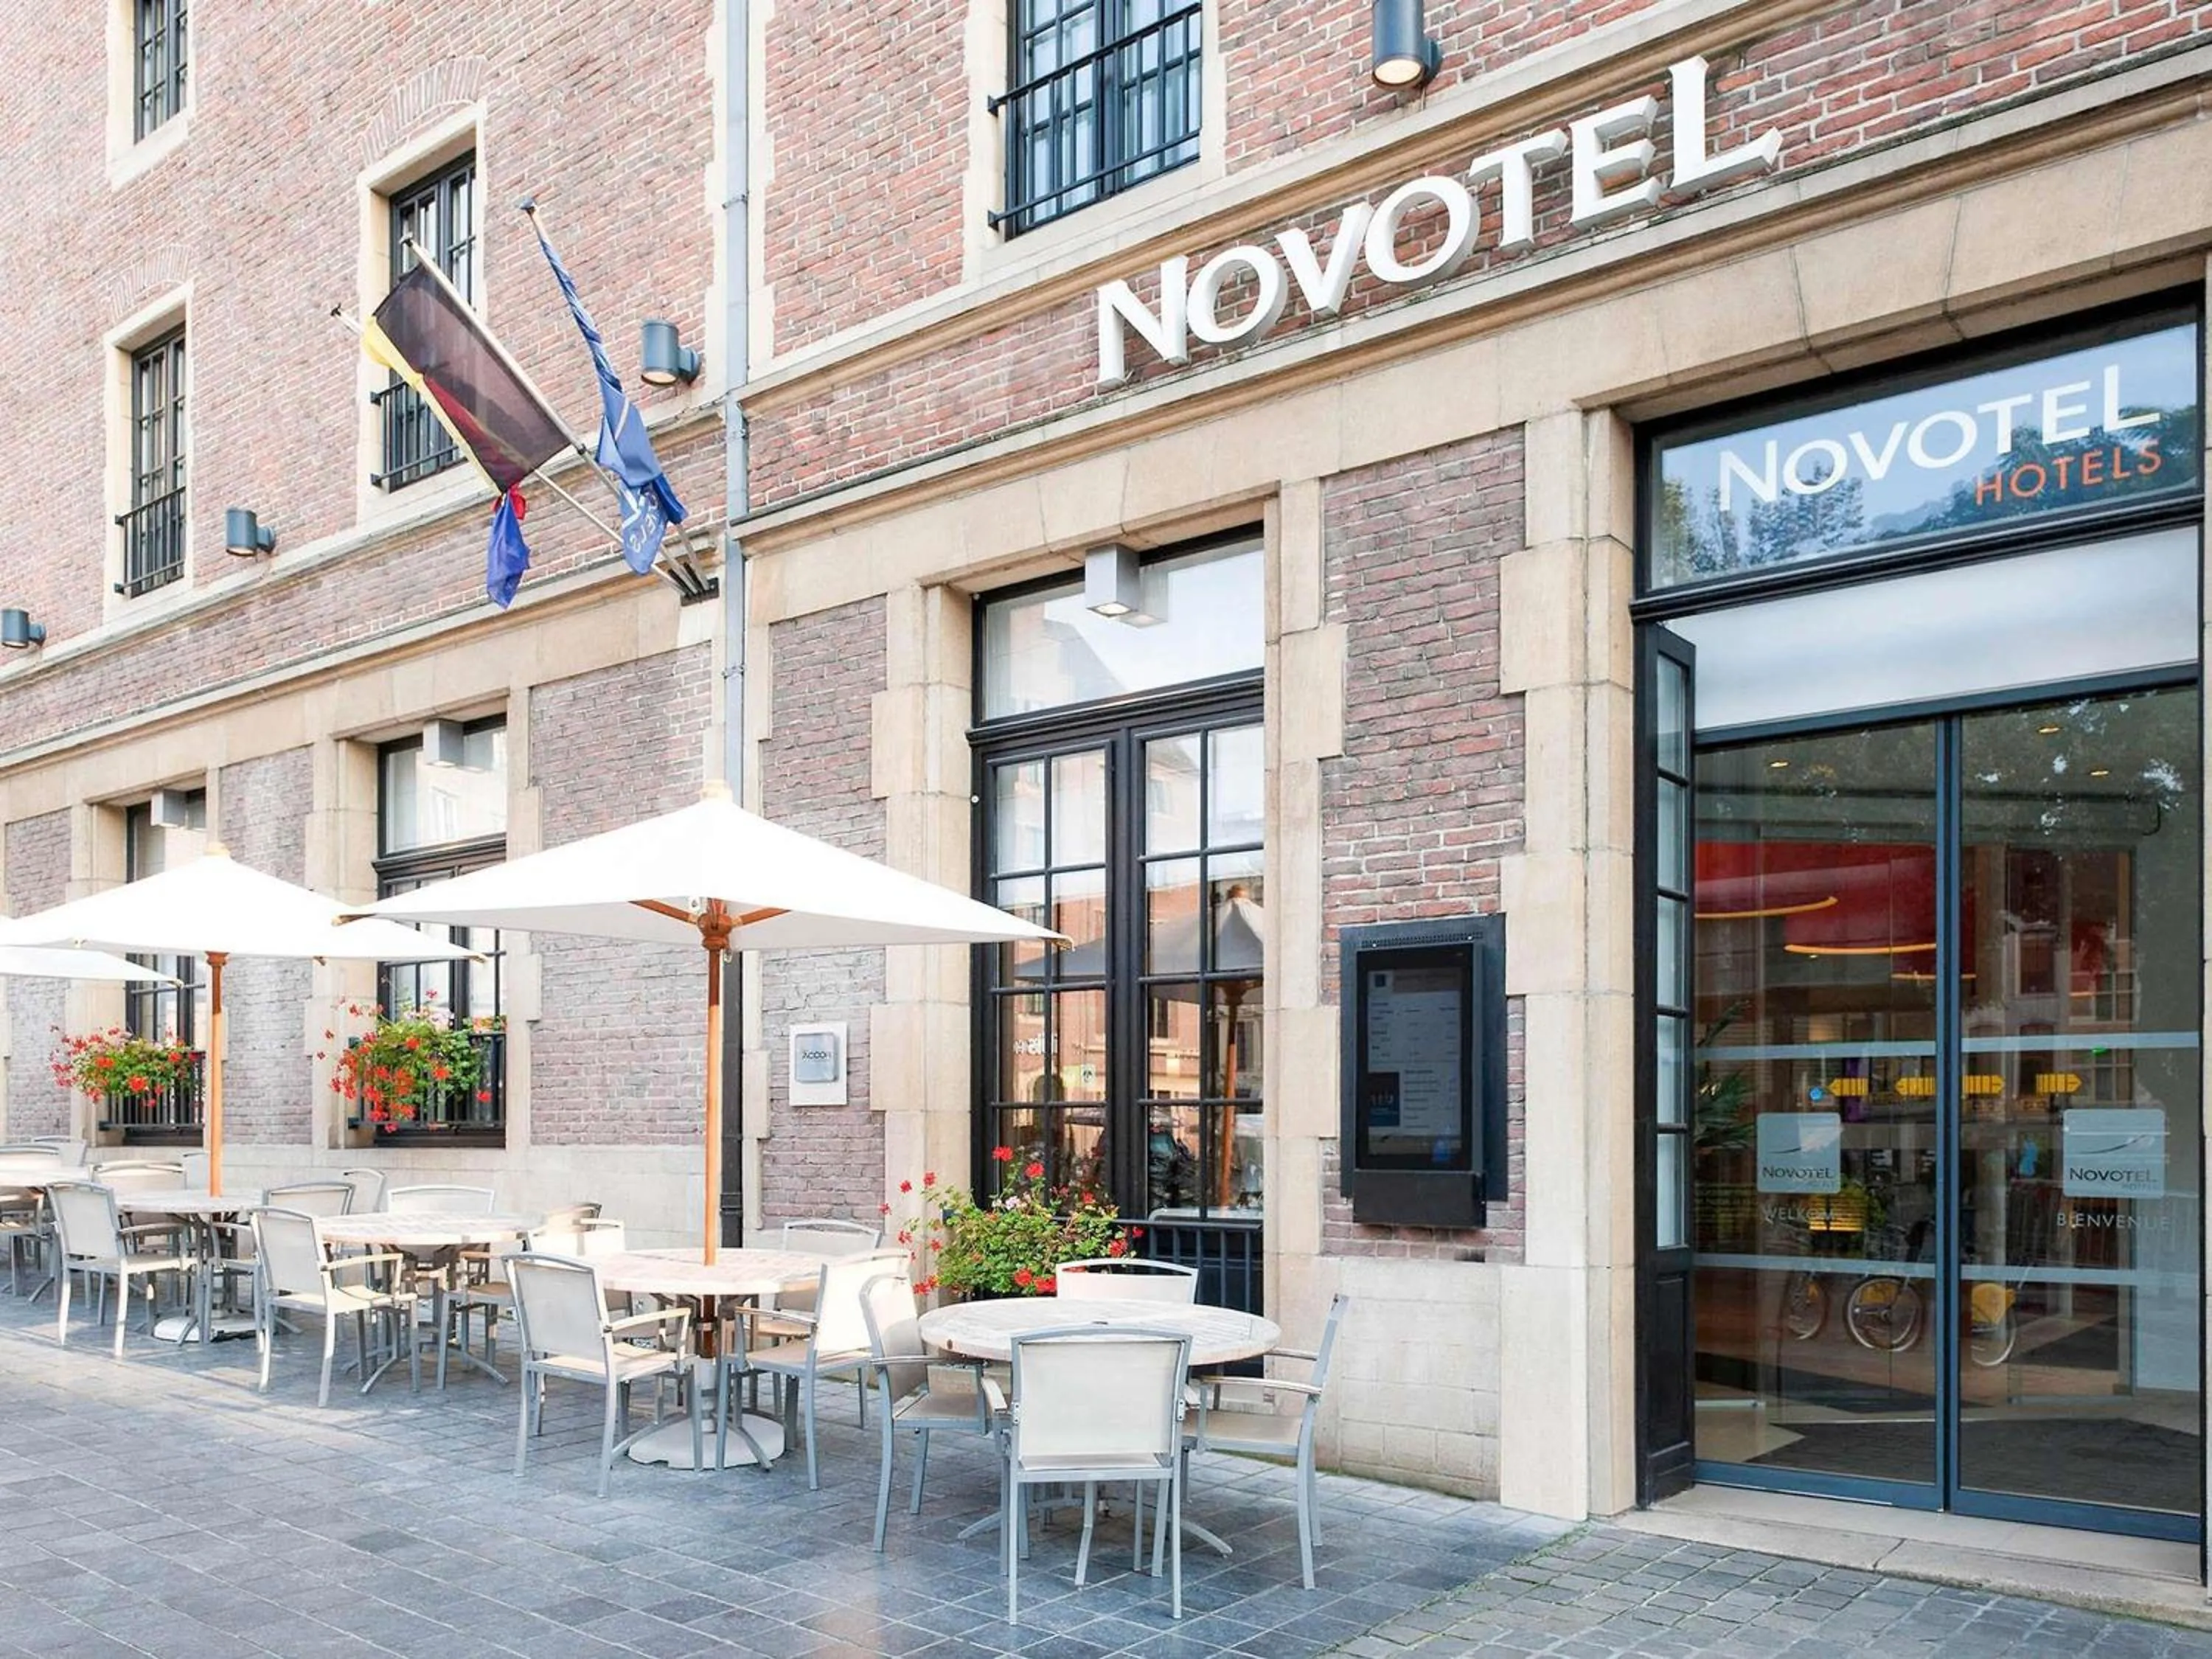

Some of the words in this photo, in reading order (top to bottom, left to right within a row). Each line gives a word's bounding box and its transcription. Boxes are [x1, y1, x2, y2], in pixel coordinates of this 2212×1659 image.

[1096, 55, 1784, 390] NOVOTEL
[1719, 364, 2161, 512] NOVOTEL
[1975, 439, 2163, 506] HOTELS
[1762, 1166, 1836, 1179] NOVOTEL
[2069, 1167, 2157, 1182] NOVOTEL
[2056, 1212, 2171, 1231] BIENVENUE
